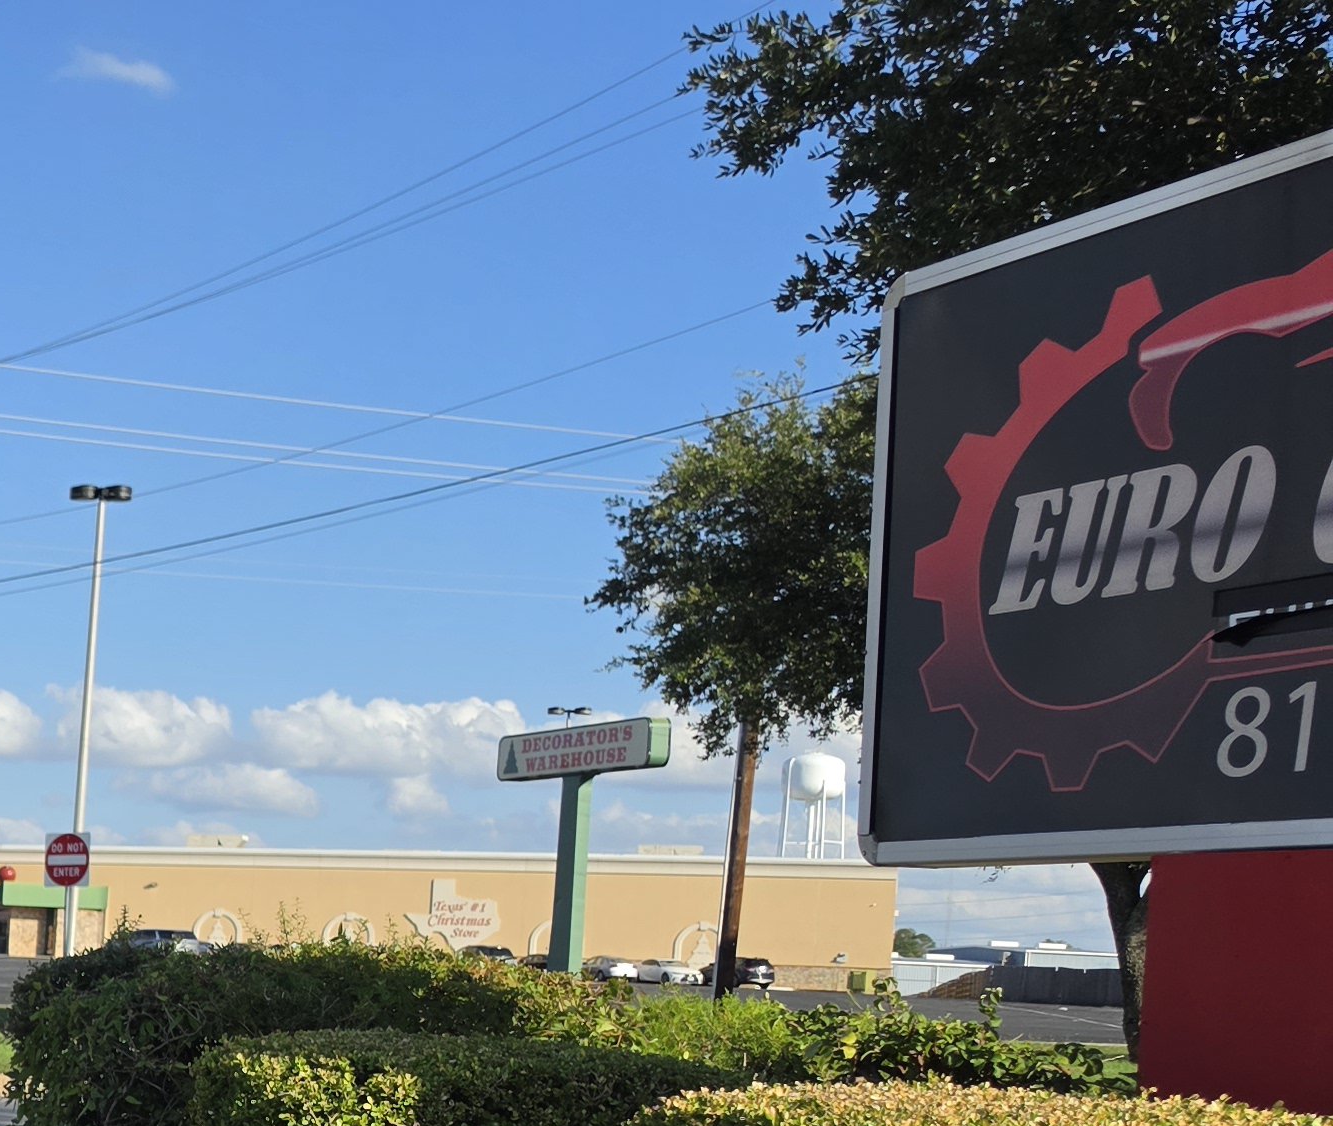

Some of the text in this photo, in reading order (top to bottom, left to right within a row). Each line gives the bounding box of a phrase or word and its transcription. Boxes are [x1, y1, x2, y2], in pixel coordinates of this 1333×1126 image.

[988, 445, 1277, 616] EURO
[521, 725, 633, 754] DECORATOR'S
[1217, 681, 1317, 778] 81
[525, 747, 627, 773] WAREHOUSE
[51, 842, 84, 853] DO NOT
[53, 867, 80, 877] ENTER
[427, 914, 492, 928] Christmas
[450, 928, 480, 938] Store
